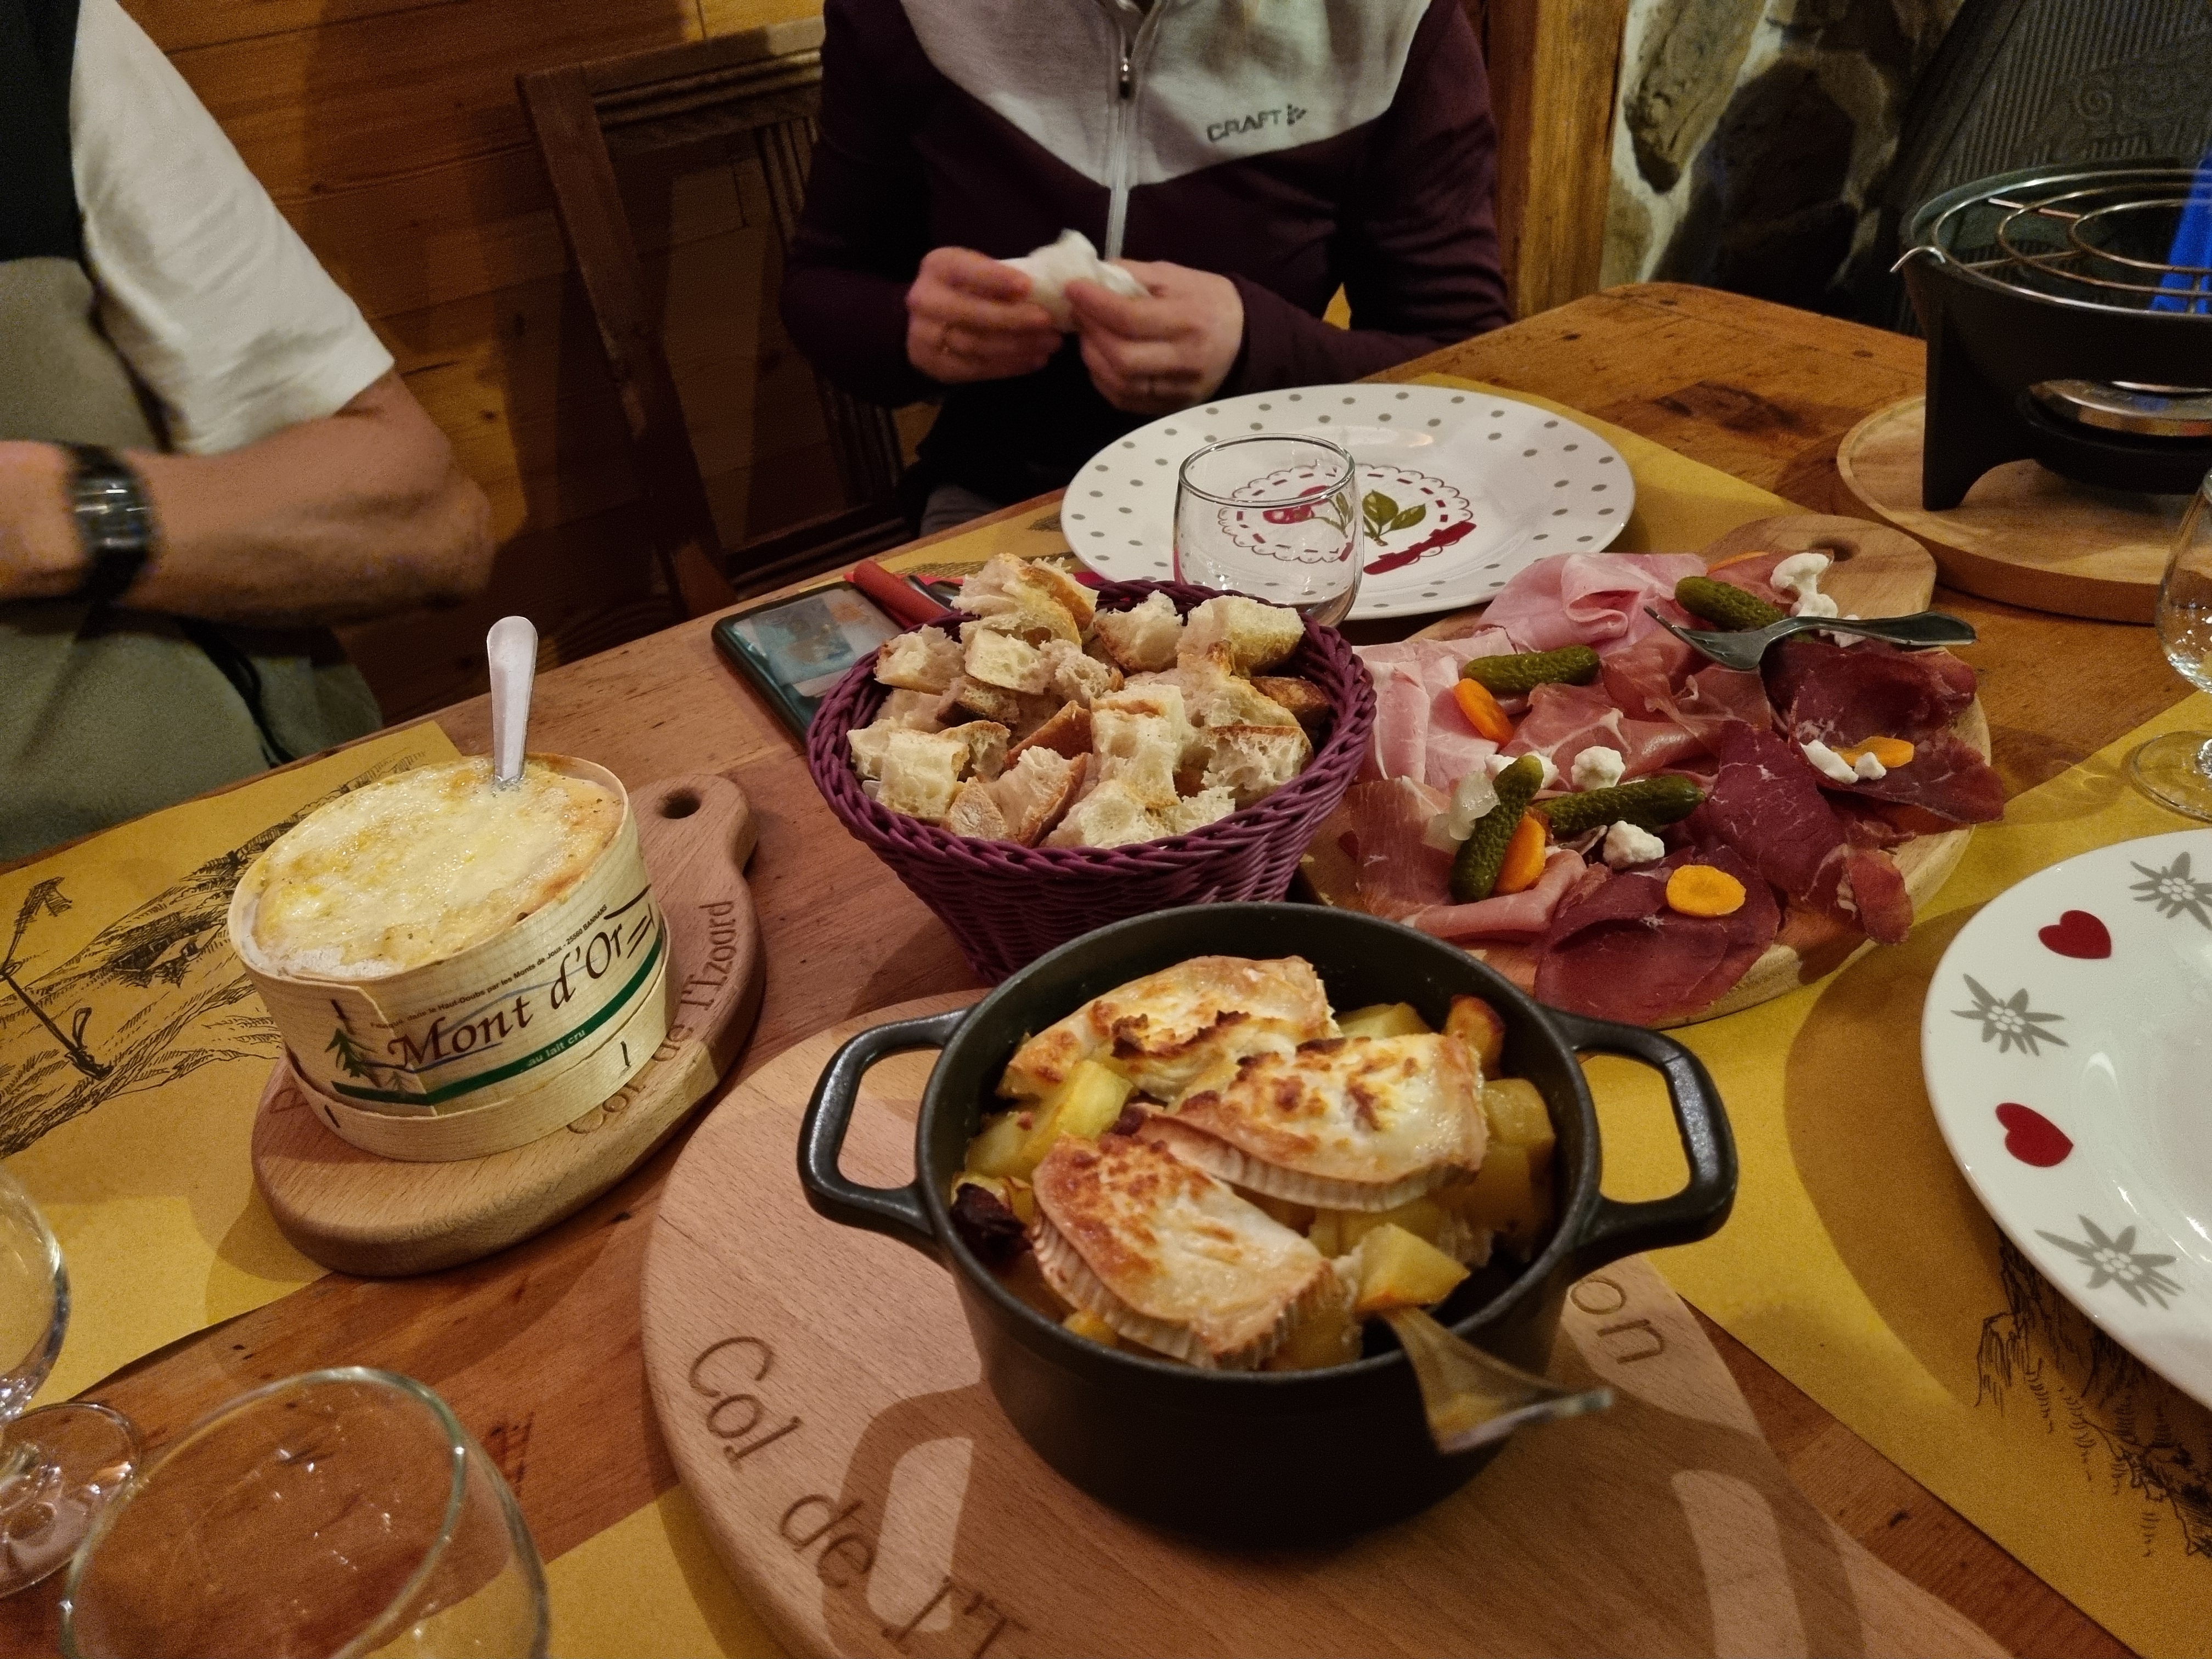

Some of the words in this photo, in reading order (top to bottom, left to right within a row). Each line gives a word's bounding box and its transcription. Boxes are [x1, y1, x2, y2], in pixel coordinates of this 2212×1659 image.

[1206, 109, 1282, 143] CRAFT
[387, 995, 534, 1066] Mont
[551, 923, 623, 1011] d'Or
[407, 1011, 427, 1021] dans
[437, 990, 486, 1011] Haut-Doubs
[487, 983, 499, 994] par
[500, 977, 512, 986] les
[513, 964, 536, 979] Monts
[537, 957, 546, 966] de
[547, 945, 563, 960] Joux
[582, 904, 608, 931] BANNANS
[528, 1054, 544, 1066] au
[545, 1042, 566, 1057] lait
[567, 1030, 586, 1045] cru
[651, 1024, 695, 1062] de
[1570, 1276, 1666, 1365] on
[689, 1336, 804, 1470] Col
[778, 1494, 878, 1589] de
